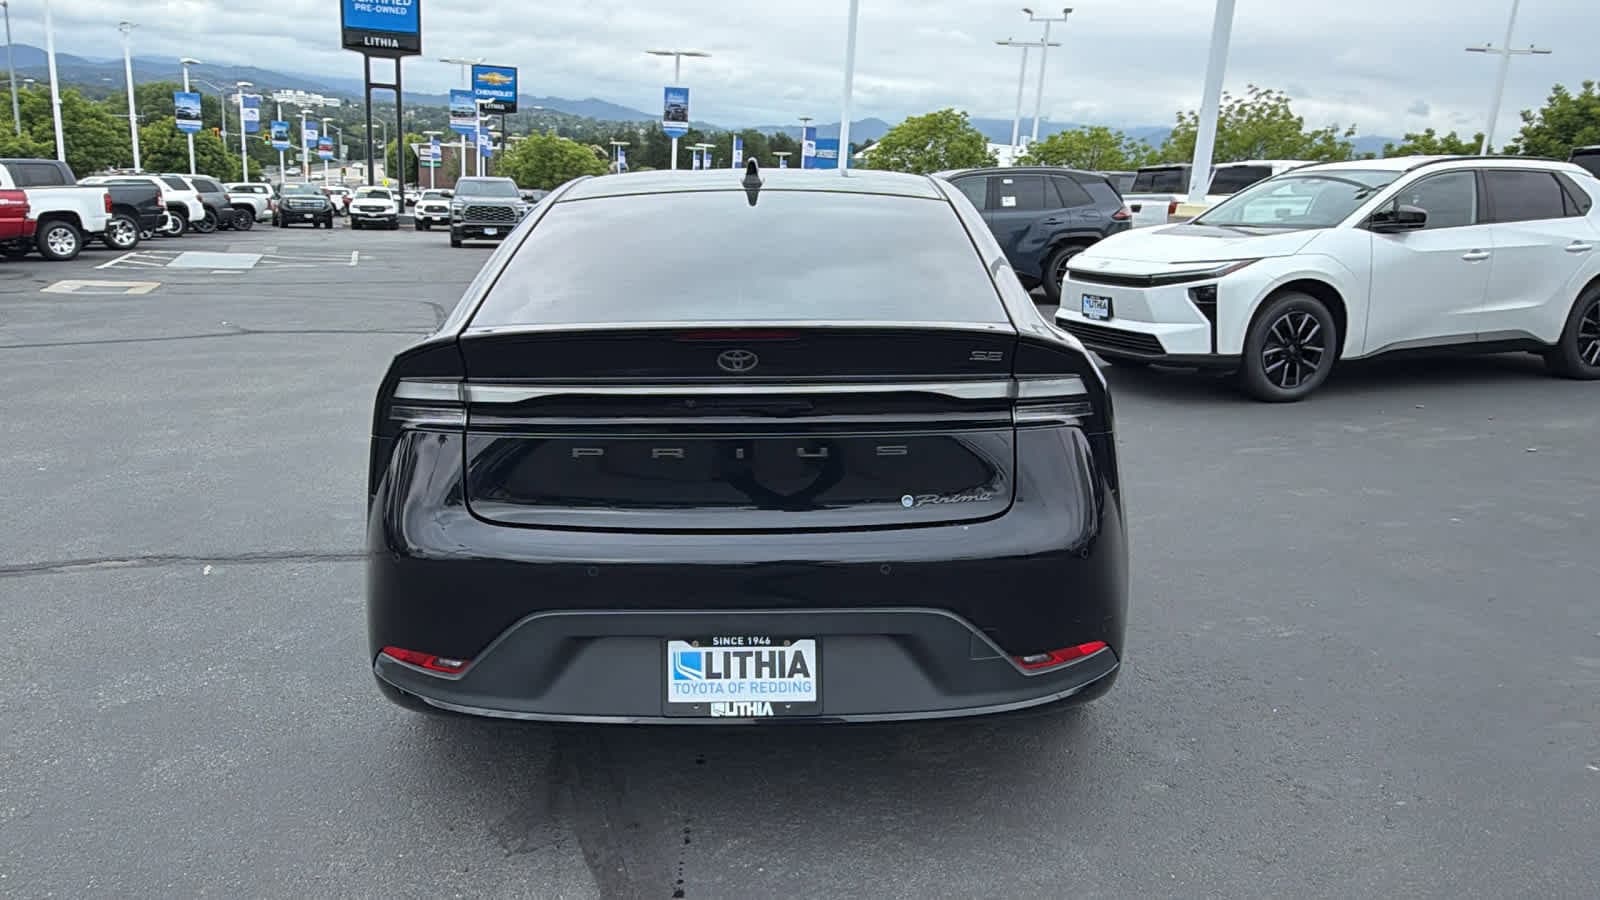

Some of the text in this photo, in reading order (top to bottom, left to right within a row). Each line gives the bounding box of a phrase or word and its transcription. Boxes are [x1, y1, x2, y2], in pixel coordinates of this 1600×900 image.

[354, 3, 407, 15] PRE-OWNED
[364, 37, 399, 48] LITHIA
[475, 89, 513, 97] CHEVROLET
[969, 351, 1003, 361] SE
[572, 446, 908, 459] PRIUS
[712, 637, 771, 646] SINCE 1946
[705, 650, 810, 679] LITHIA
[673, 681, 812, 695] TOYOTA OF REDDING
[726, 702, 774, 716] LITHIA
